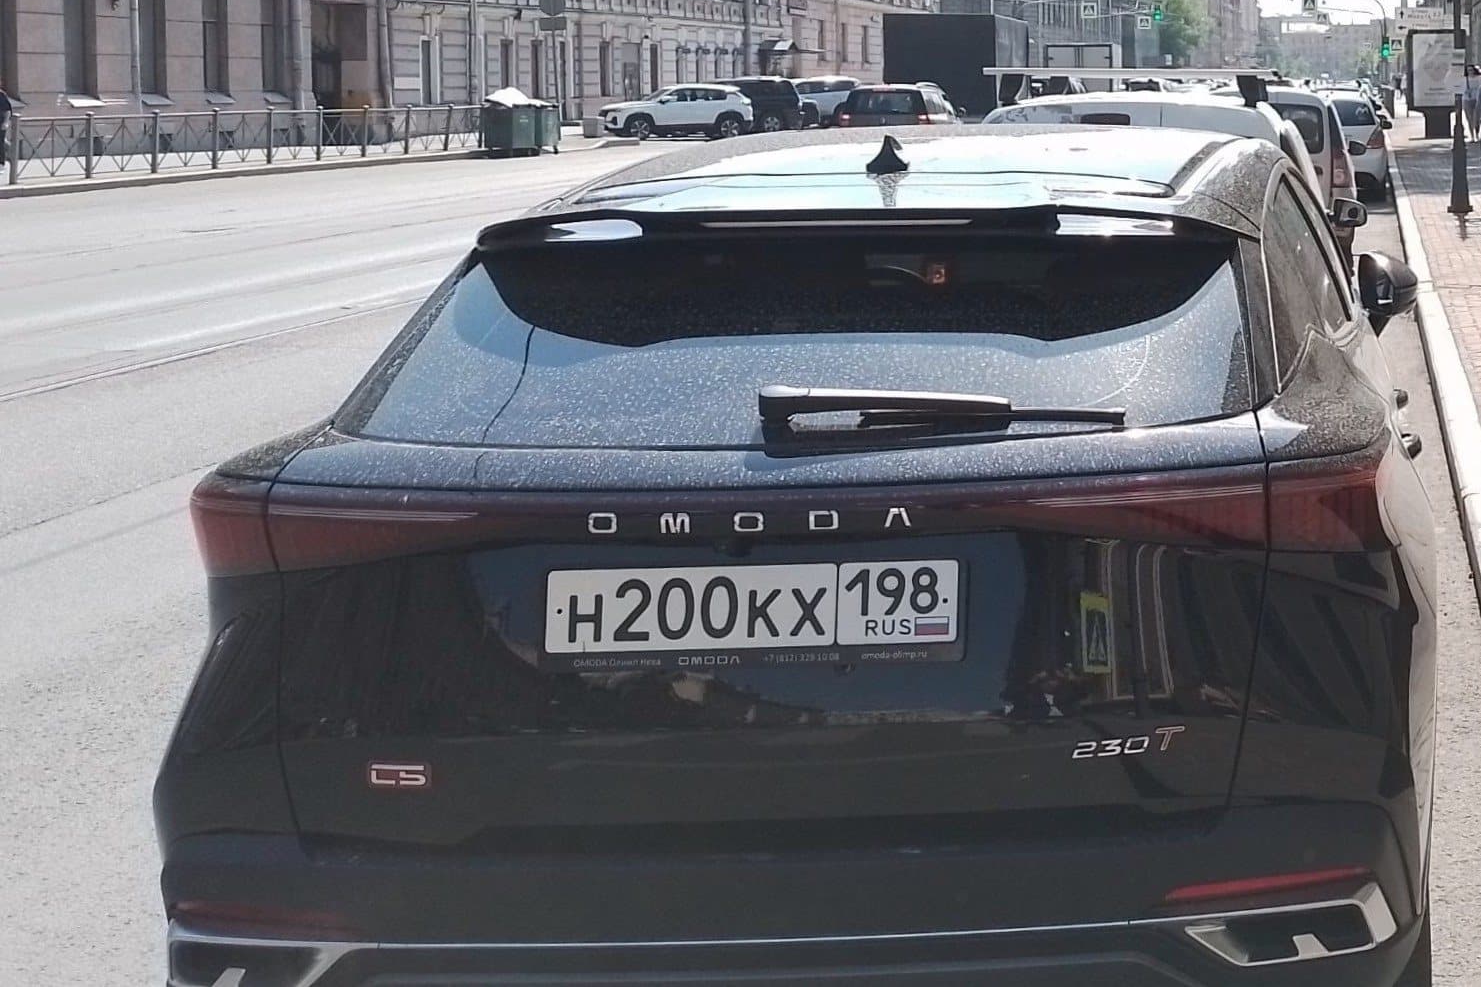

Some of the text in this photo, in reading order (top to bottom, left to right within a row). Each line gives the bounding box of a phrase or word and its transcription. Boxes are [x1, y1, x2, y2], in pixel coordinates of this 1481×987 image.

[568, 567, 939, 644] Н200КХ 198
[865, 619, 911, 637] RUS
[678, 656, 740, 666] OMODA
